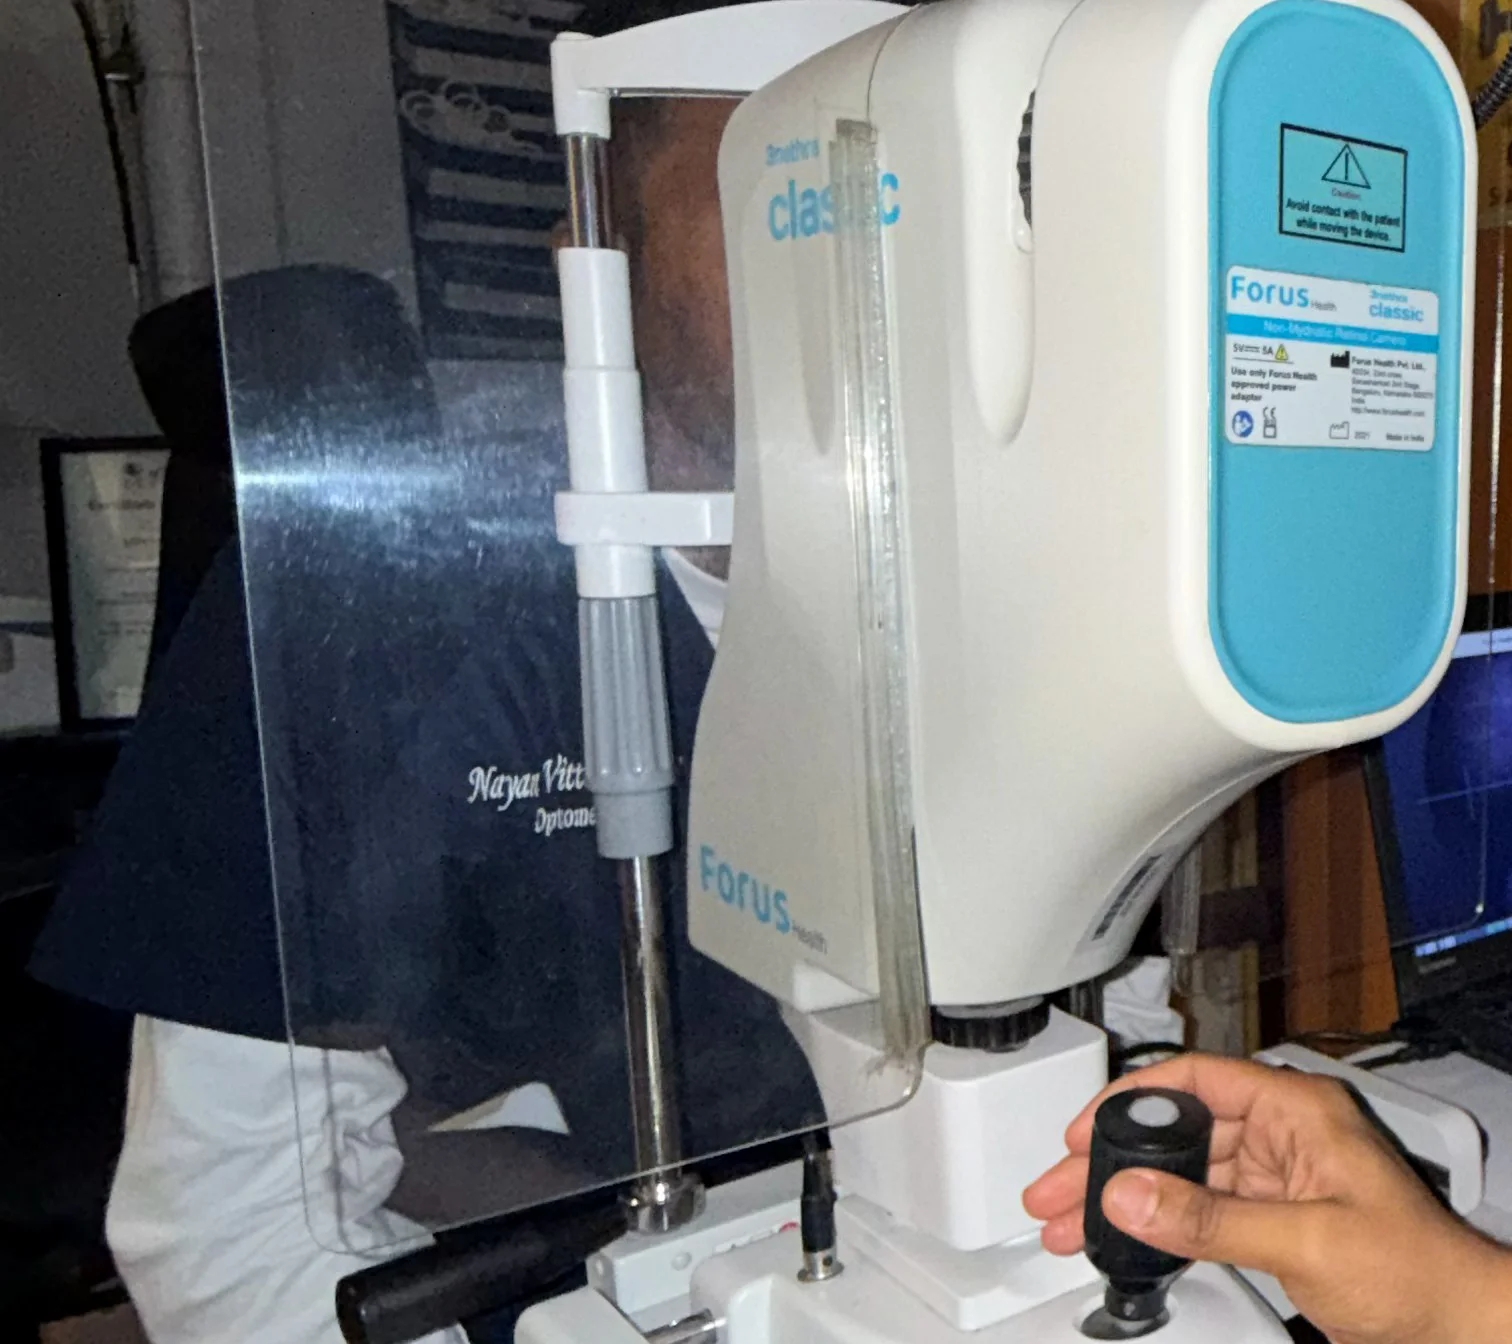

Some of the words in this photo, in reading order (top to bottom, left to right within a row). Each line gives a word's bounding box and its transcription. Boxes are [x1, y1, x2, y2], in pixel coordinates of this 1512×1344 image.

[769, 172, 900, 241] clasc
[1286, 198, 1310, 212] Avoid
[1312, 204, 1341, 217] contact
[1343, 208, 1359, 220] with
[1361, 211, 1373, 223] the
[1375, 214, 1400, 228] patient
[1296, 217, 1317, 230] while
[1319, 222, 1348, 238] moving
[1350, 225, 1362, 236] the
[1230, 274, 1310, 308] Forus
[1369, 302, 1424, 322] classic
[1231, 367, 1247, 376] Use
[1249, 369, 1266, 379] only
[1292, 371, 1318, 381] Health
[1231, 381, 1270, 391] approved
[1271, 383, 1296, 393] power
[467, 766, 541, 812] Nayan
[700, 843, 791, 936] Forus
